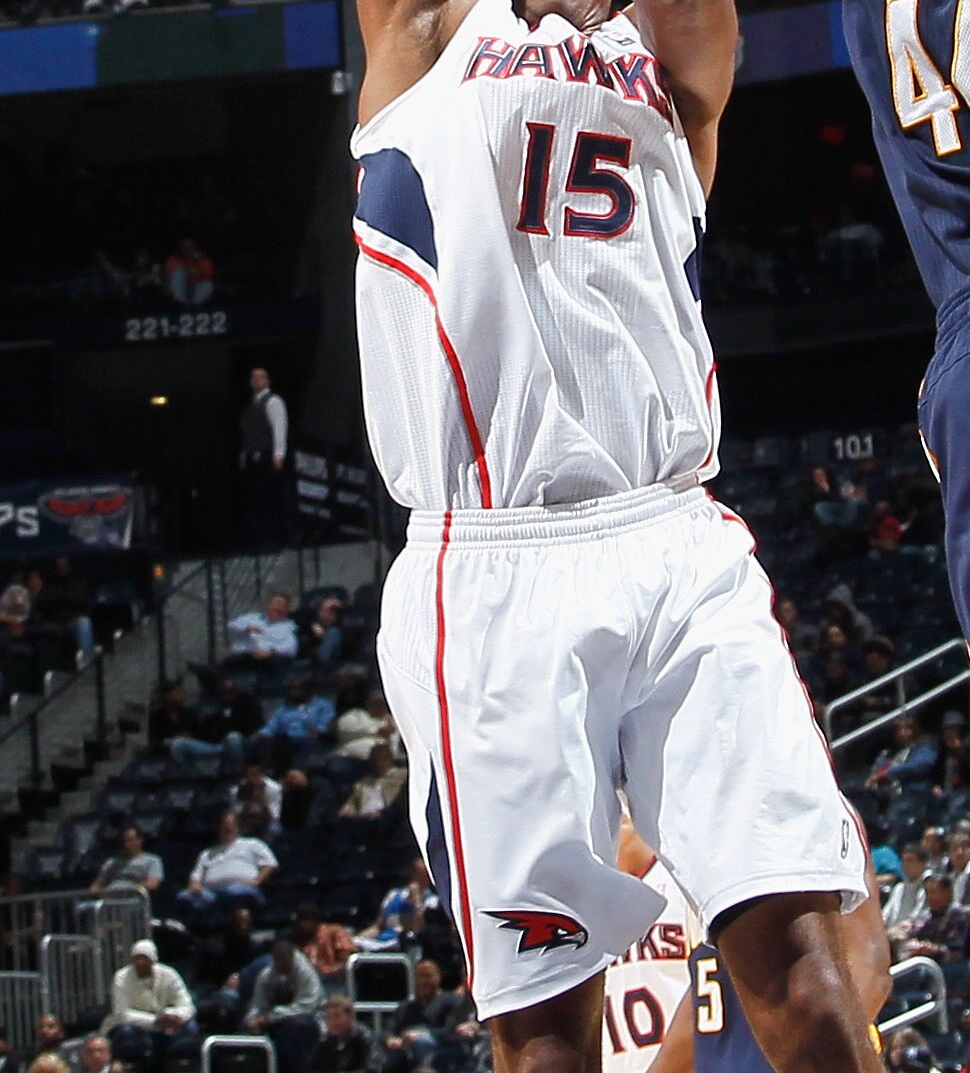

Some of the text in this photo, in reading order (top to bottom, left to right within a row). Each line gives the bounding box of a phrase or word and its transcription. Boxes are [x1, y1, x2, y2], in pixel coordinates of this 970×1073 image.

[515, 121, 636, 239] 15
[125, 310, 227, 341] 221-222
[833, 434, 874, 460] 101
[696, 956, 725, 1035] 5
